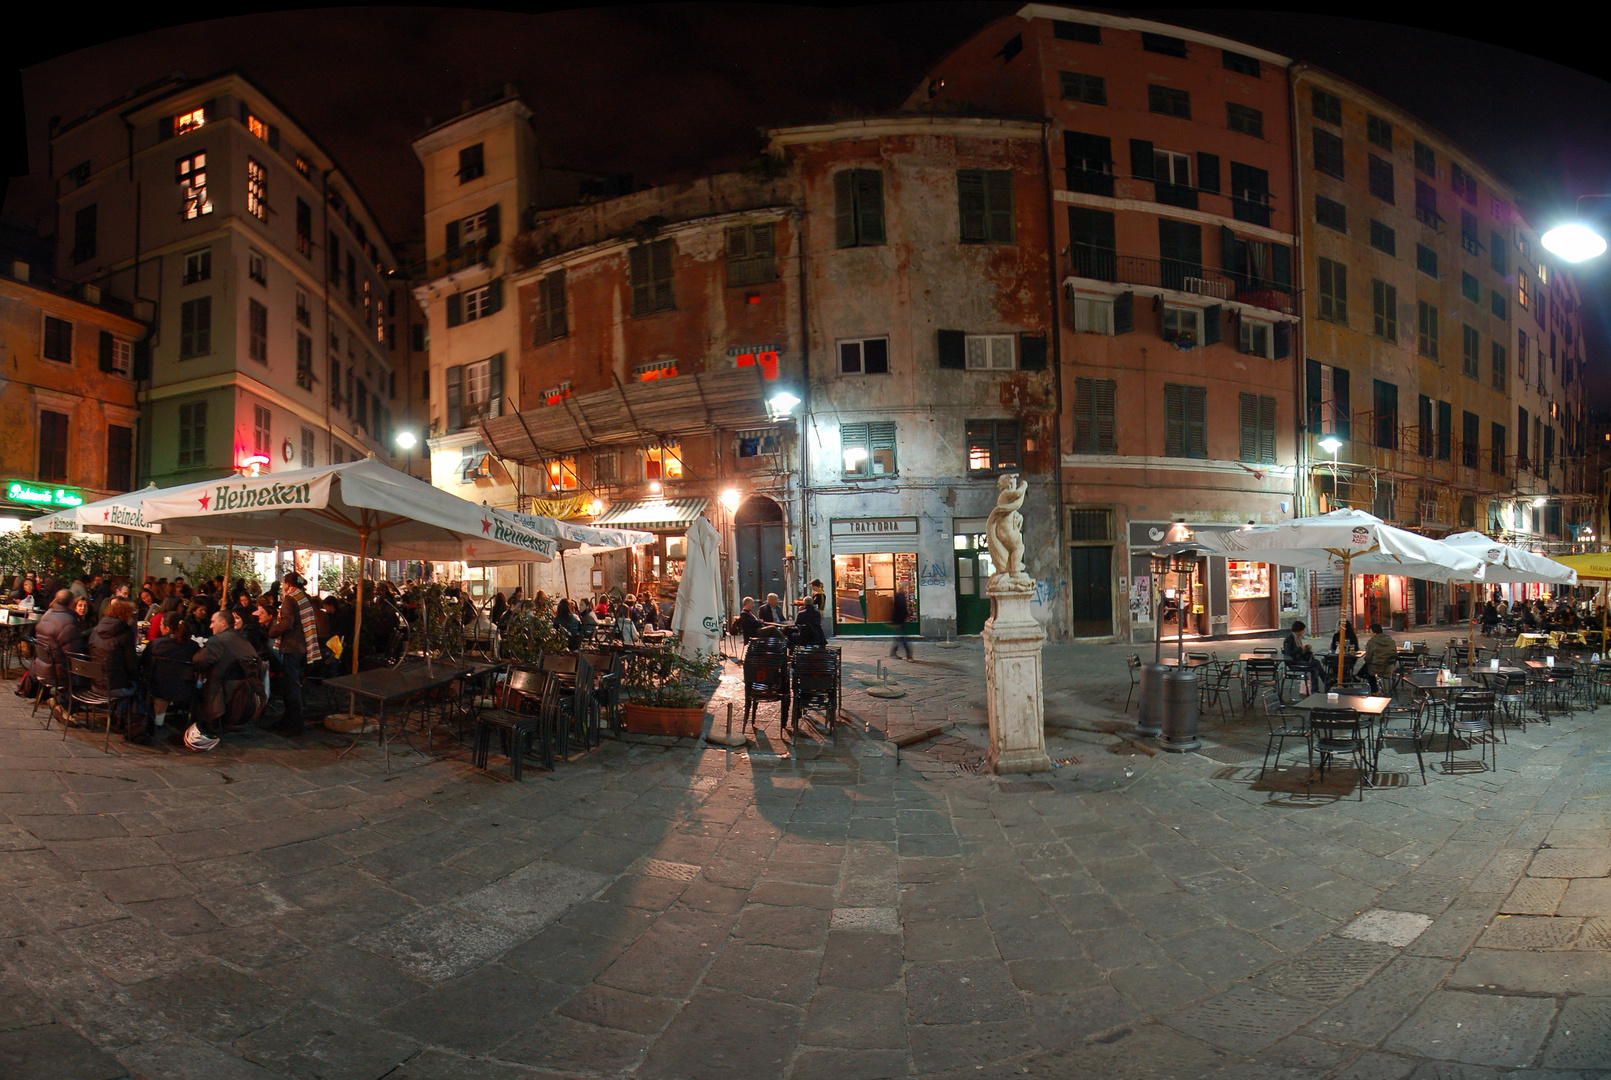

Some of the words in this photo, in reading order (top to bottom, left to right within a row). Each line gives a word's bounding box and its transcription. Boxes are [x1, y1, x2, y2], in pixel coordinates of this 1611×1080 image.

[213, 482, 311, 511] Heineken
[110, 505, 153, 529] Heinek
[850, 521, 899, 532] TRATTORIA
[493, 517, 552, 556] Heineken
[920, 579, 946, 587] 2003
